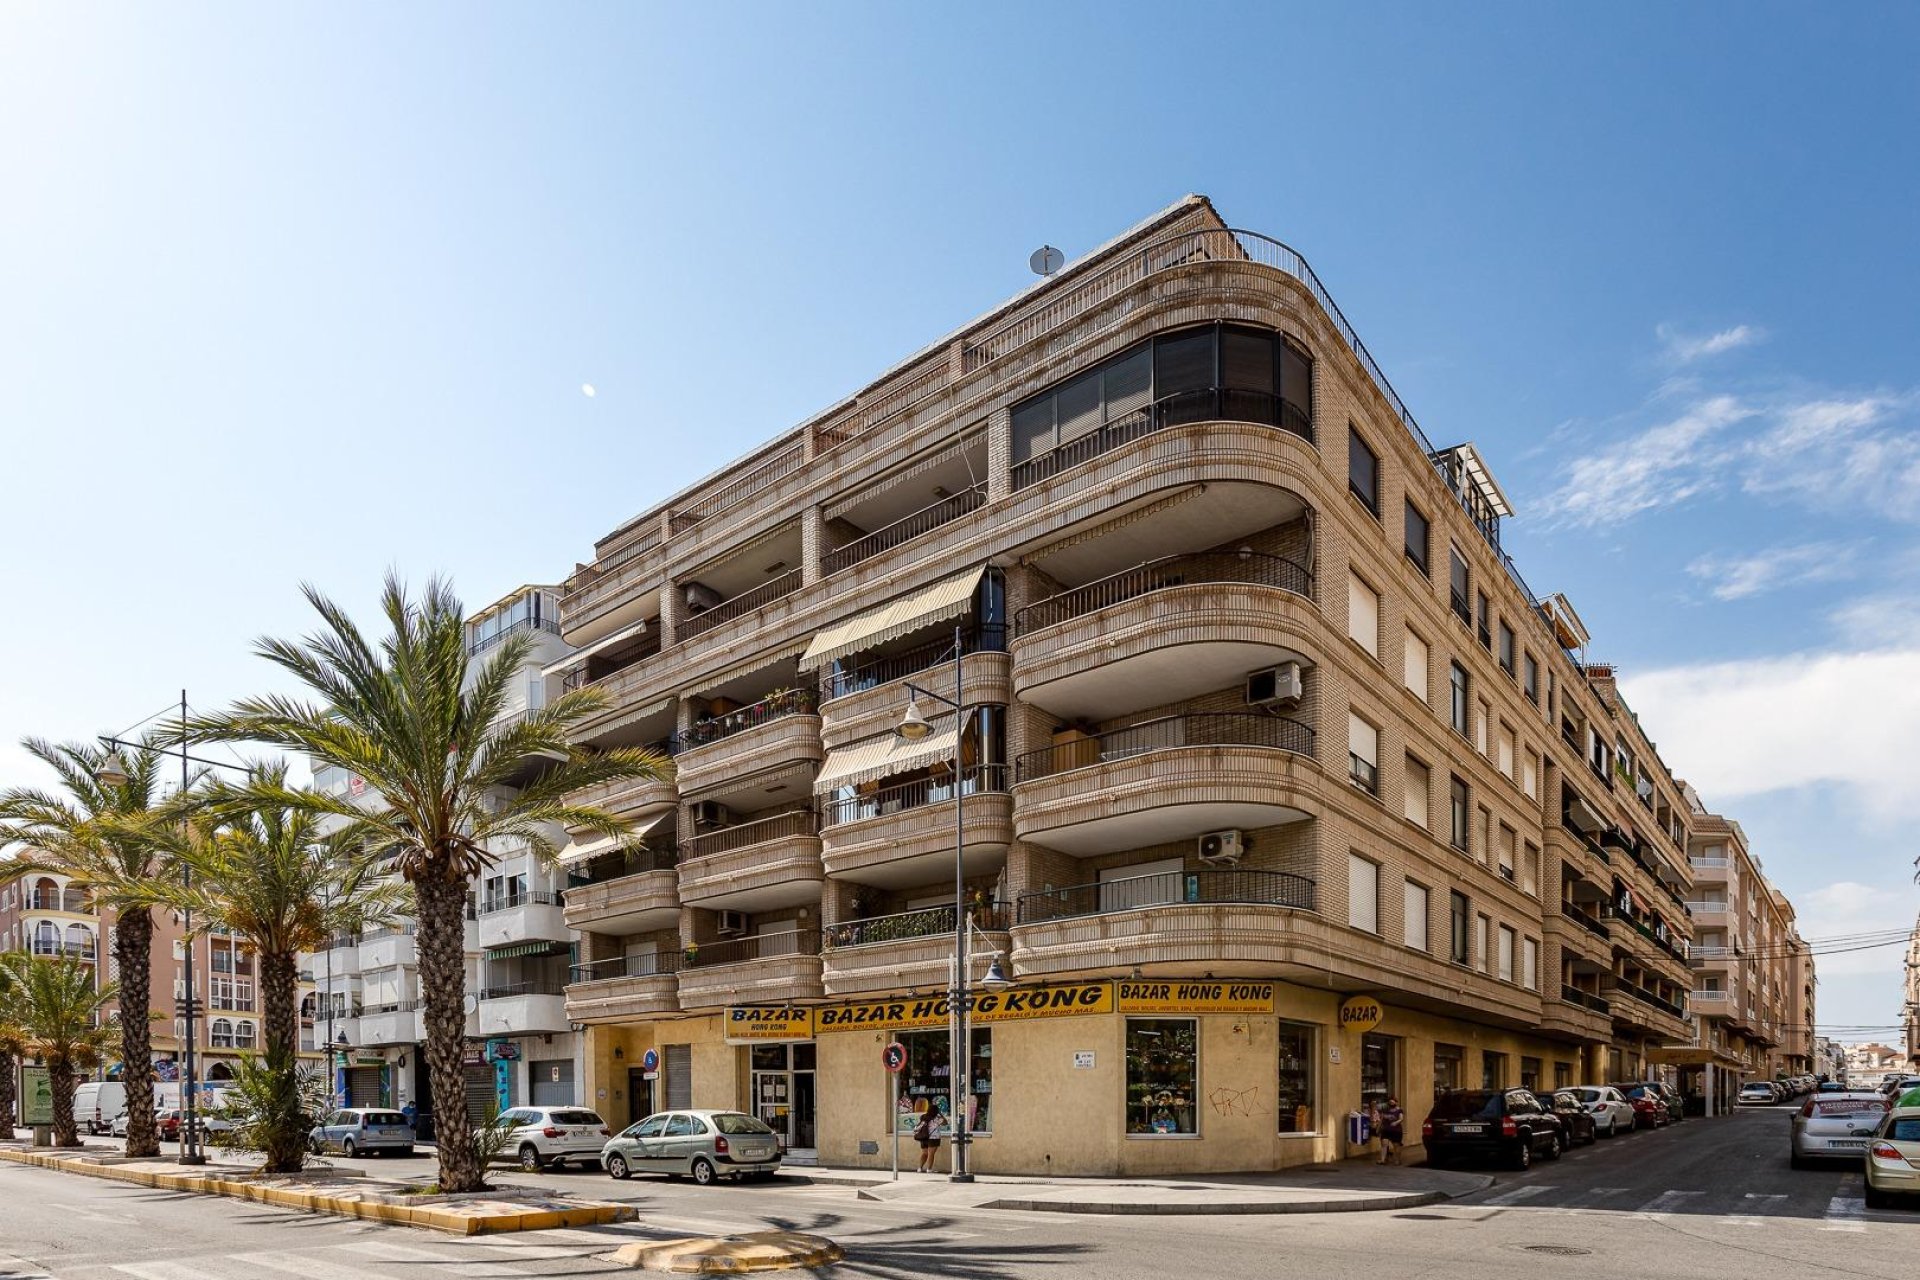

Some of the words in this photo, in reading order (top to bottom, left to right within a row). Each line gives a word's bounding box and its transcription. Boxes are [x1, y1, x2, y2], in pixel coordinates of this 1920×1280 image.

[1120, 984, 1171, 1000] BAZAR
[1177, 984, 1223, 1000] HONG
[1228, 984, 1273, 1001] KONG
[821, 1003, 905, 1025] BAZAR
[912, 995, 999, 1019] HOG
[1004, 986, 1103, 1011] KONG
[1342, 1005, 1378, 1022] BAZAR
[731, 1009, 807, 1021] BAZAR
